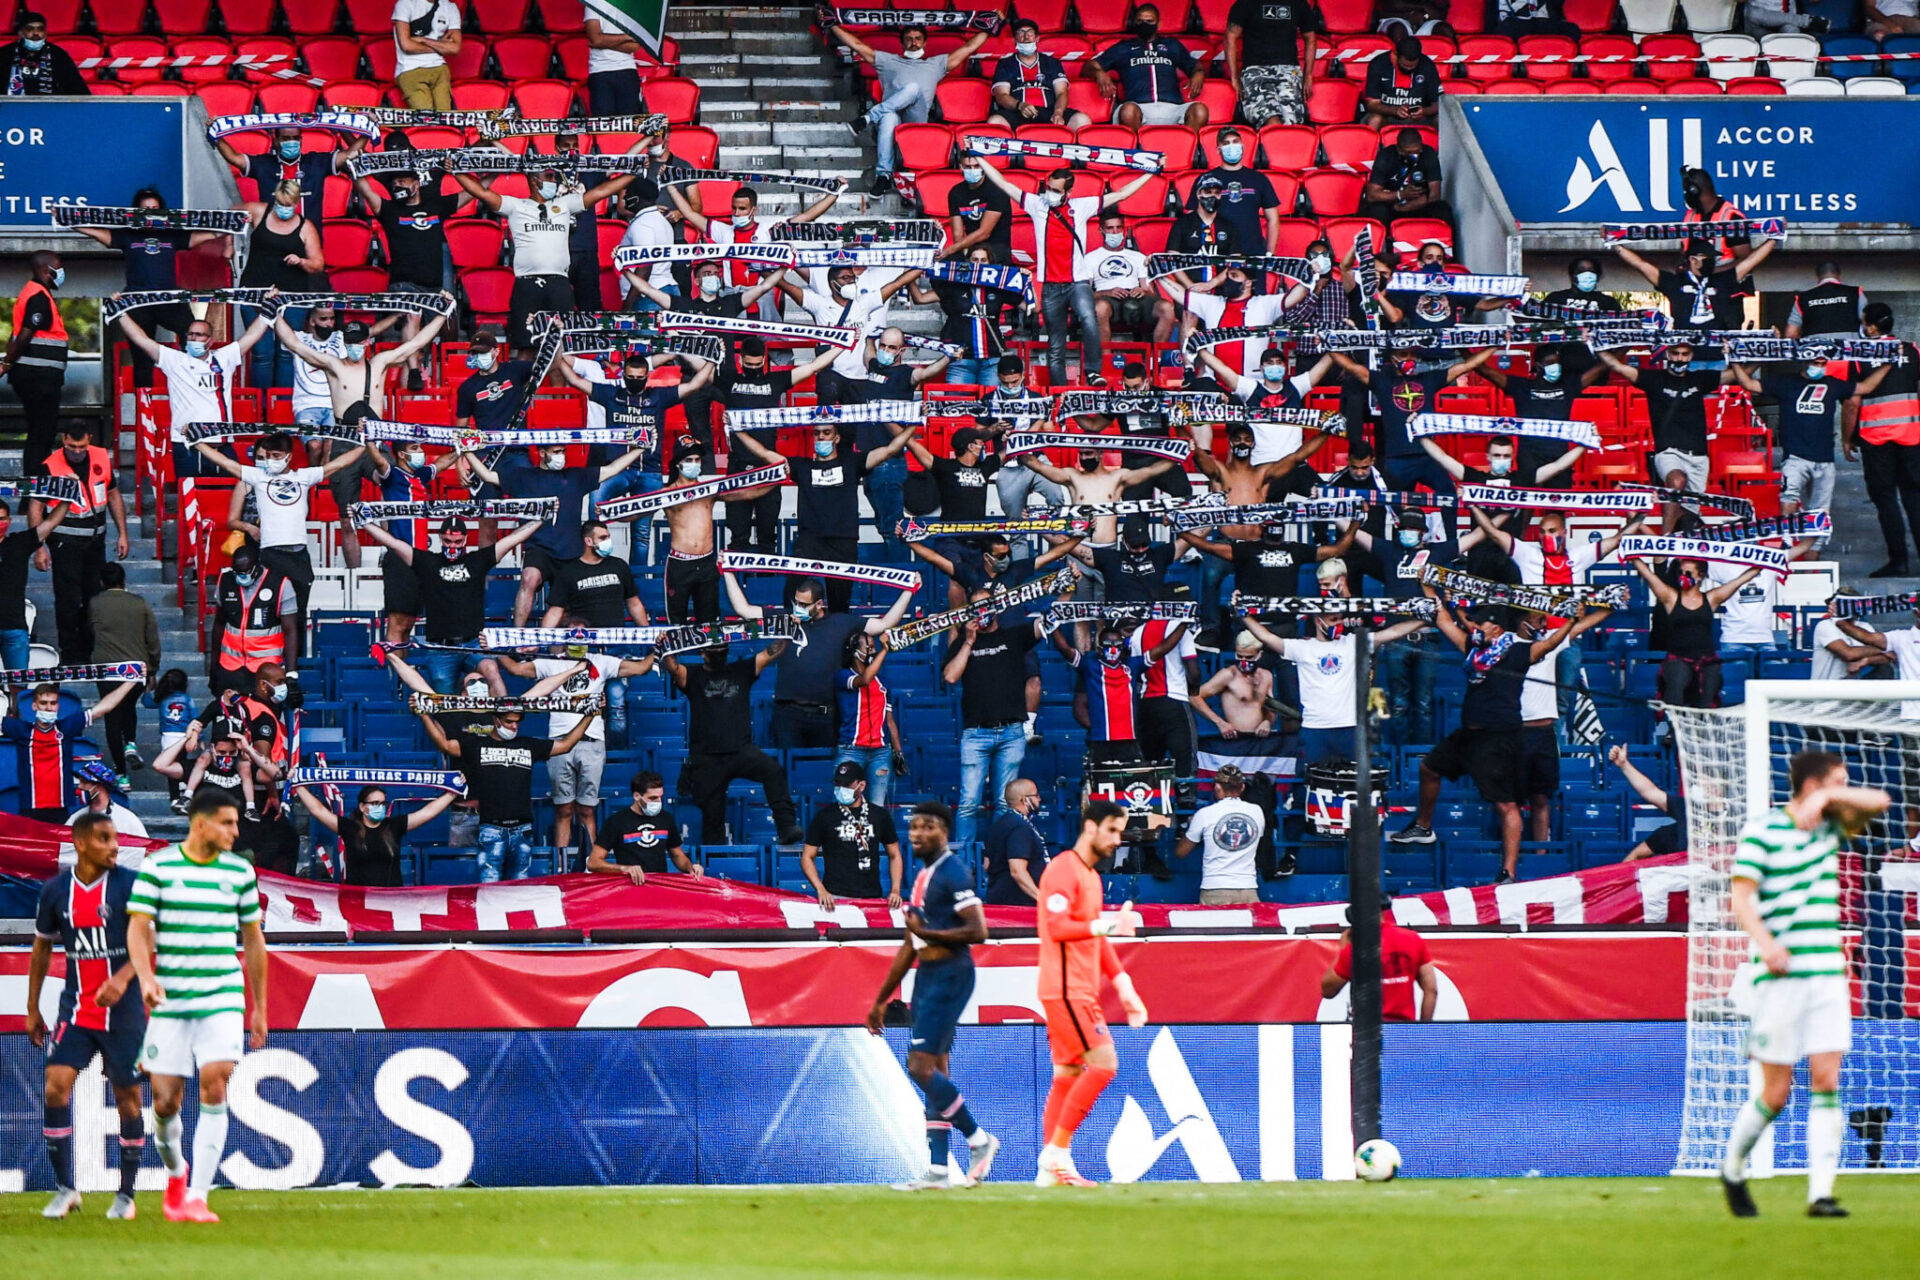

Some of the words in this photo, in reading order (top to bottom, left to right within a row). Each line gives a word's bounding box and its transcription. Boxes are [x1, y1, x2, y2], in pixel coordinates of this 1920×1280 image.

[853, 11, 913, 24] PARIS
[1130, 57, 1172, 67] Emirates
[1144, 49, 1158, 58] Fly
[1395, 88, 1409, 97] Fly
[208, 112, 291, 139] ULTRAS
[590, 117, 634, 131] TEAM
[0, 128, 45, 146] OR
[1716, 127, 1814, 144] ACCOR
[1716, 161, 1775, 178] LIVE
[1716, 193, 1857, 211] IMITLESS
[56, 208, 127, 226] ULTRAS
[186, 210, 247, 231] PARIS
[618, 247, 672, 264] VIRAGE
[677, 247, 689, 256] 19
[707, 246, 720, 255] 91
[726, 245, 790, 260] AUTEUIL
[664, 313, 728, 328] VIRAGE
[781, 325, 849, 343] AUTEUIL
[668, 334, 721, 360] PARIS
[626, 405, 641, 415] Fly
[1798, 402, 1823, 412] PARIS
[613, 412, 655, 424] Emirates
[1273, 407, 1322, 427] TEAM
[1118, 438, 1191, 457] AUTEUIL
[602, 497, 663, 521] VIRAGE
[668, 491, 681, 502] 19
[698, 485, 711, 497] 91
[717, 465, 783, 494] AUTEUIL
[1468, 487, 1528, 502] VIRAGE
[1581, 494, 1648, 507] AUTEUIL
[1622, 537, 1676, 551] VIRAGE
[1681, 541, 1694, 550] 19
[1713, 544, 1726, 554] 91
[1730, 545, 1788, 567] AUTEUI
[727, 554, 789, 568] VIRAGE
[845, 566, 911, 584] AUTEUIL
[1399, 567, 1420, 577] PAR
[354, 770, 402, 783] ULTRAS
[407, 772, 446, 785] PARIS
[839, 823, 875, 839] 191
